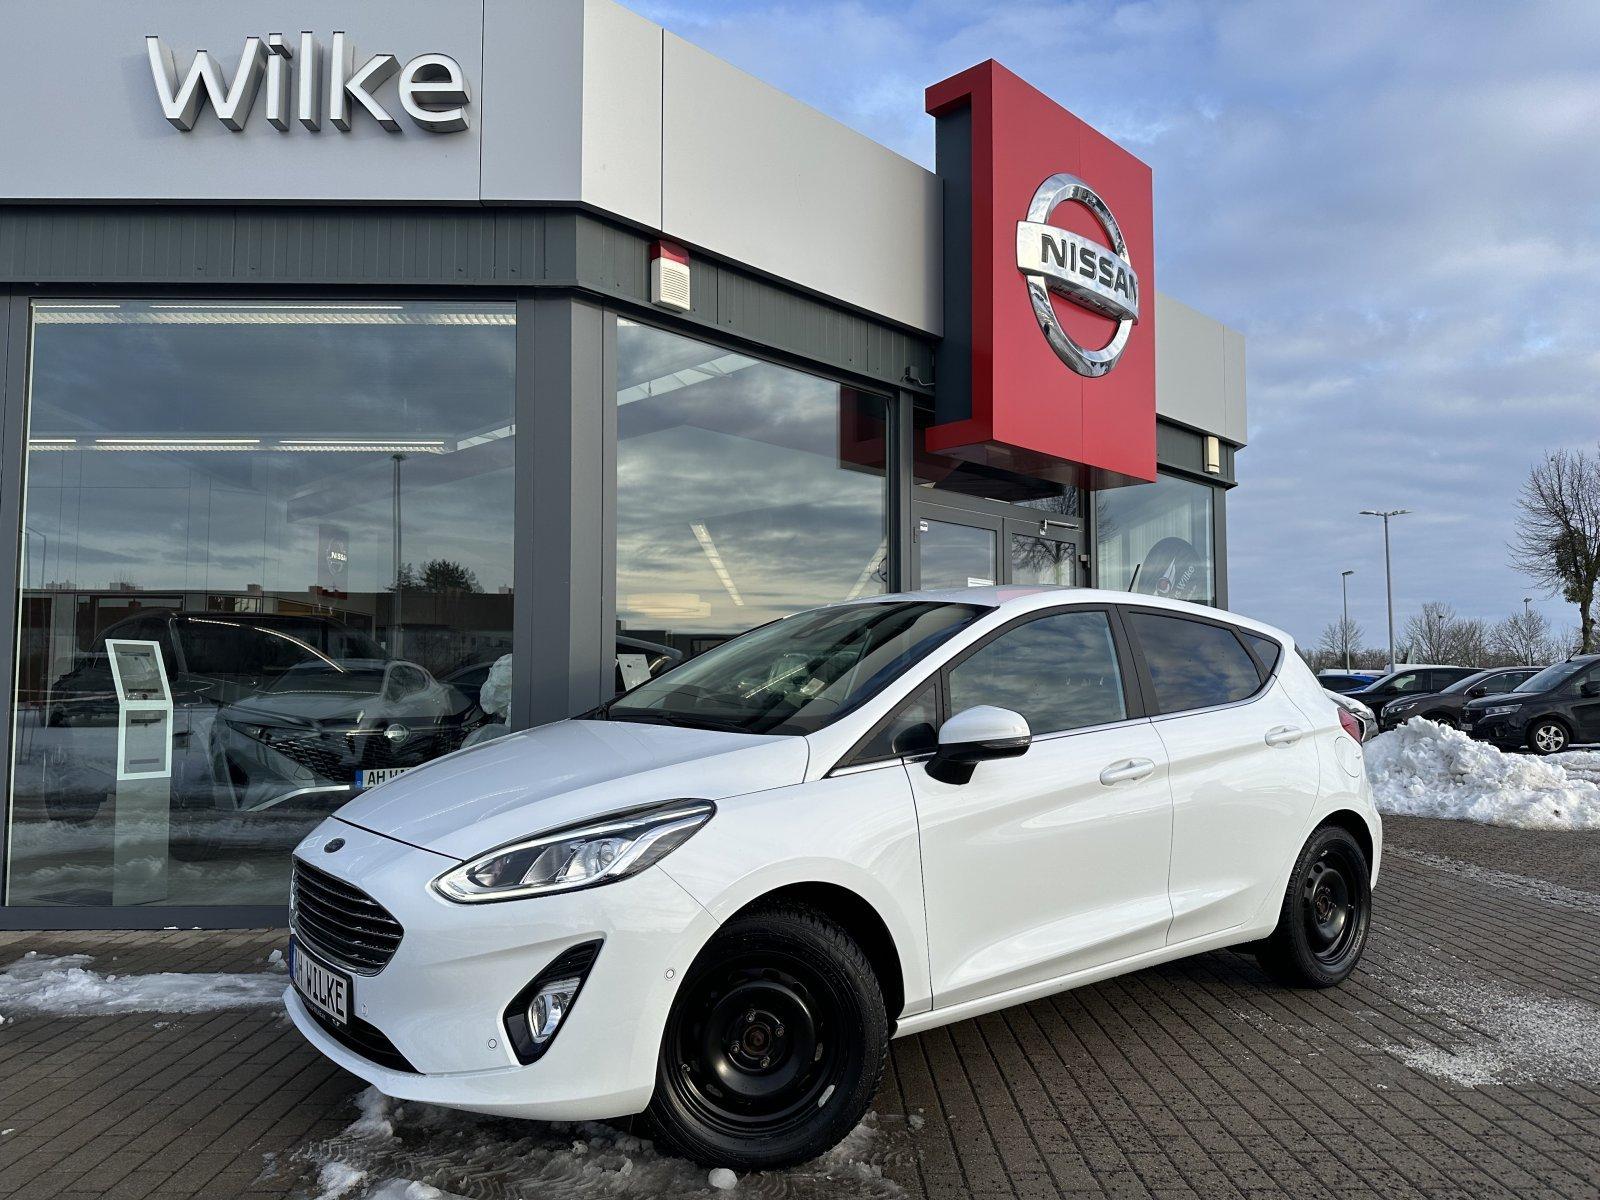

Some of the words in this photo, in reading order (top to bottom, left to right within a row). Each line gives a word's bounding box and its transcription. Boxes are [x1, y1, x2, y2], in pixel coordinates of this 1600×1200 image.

[145, 31, 471, 133] Wilke
[367, 770, 386, 785] AH
[306, 960, 345, 1018] WILKE
